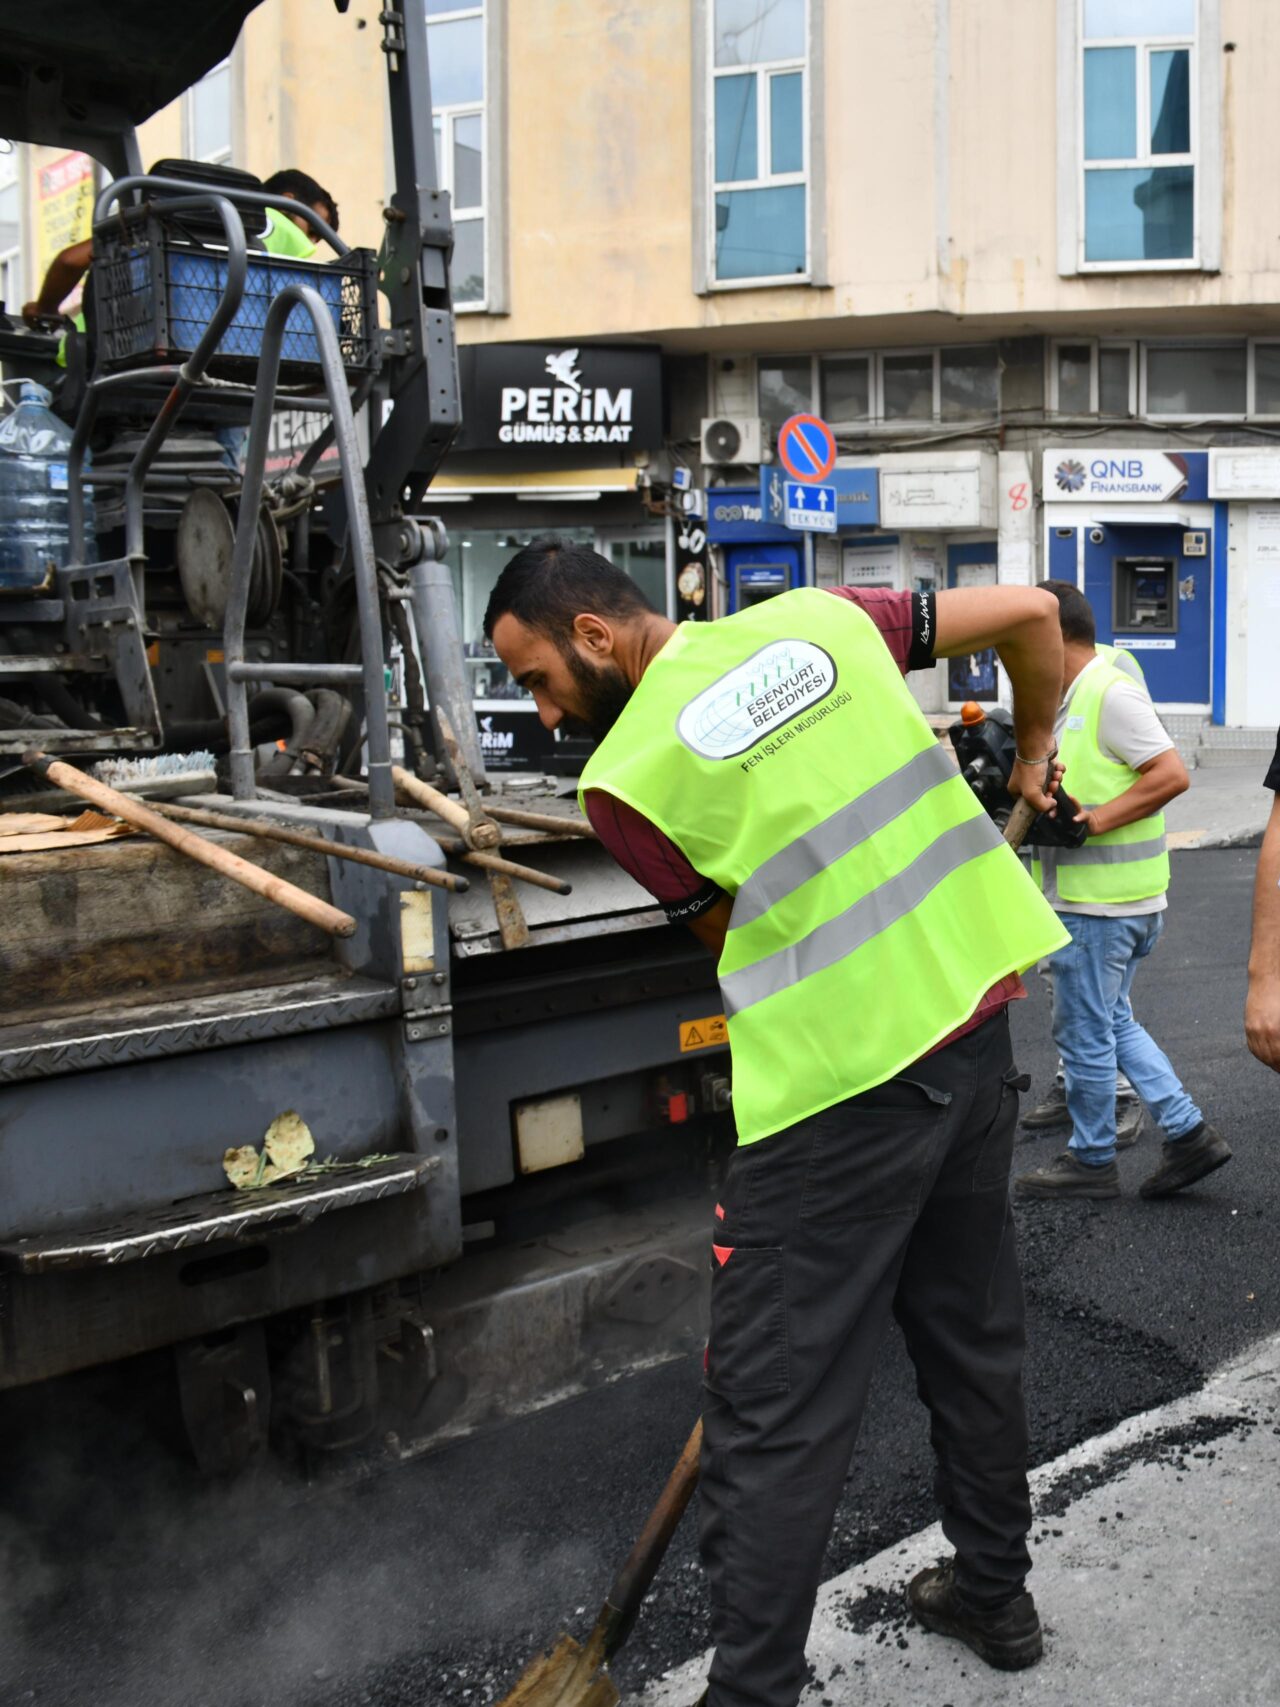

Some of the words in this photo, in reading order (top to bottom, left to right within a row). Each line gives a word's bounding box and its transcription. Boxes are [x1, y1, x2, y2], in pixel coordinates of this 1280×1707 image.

[567, 425, 582, 443] &
[583, 425, 633, 443] SAAT
[1090, 460, 1143, 479] QNB
[1008, 483, 1029, 511] 8
[792, 513, 809, 524] TEK
[747, 663, 815, 715] ESENYURT
[752, 669, 827, 728] BELEDİYESİ
[740, 752, 764, 773] FEN
[794, 690, 853, 734] MÜDÜRLÜĞÜ
